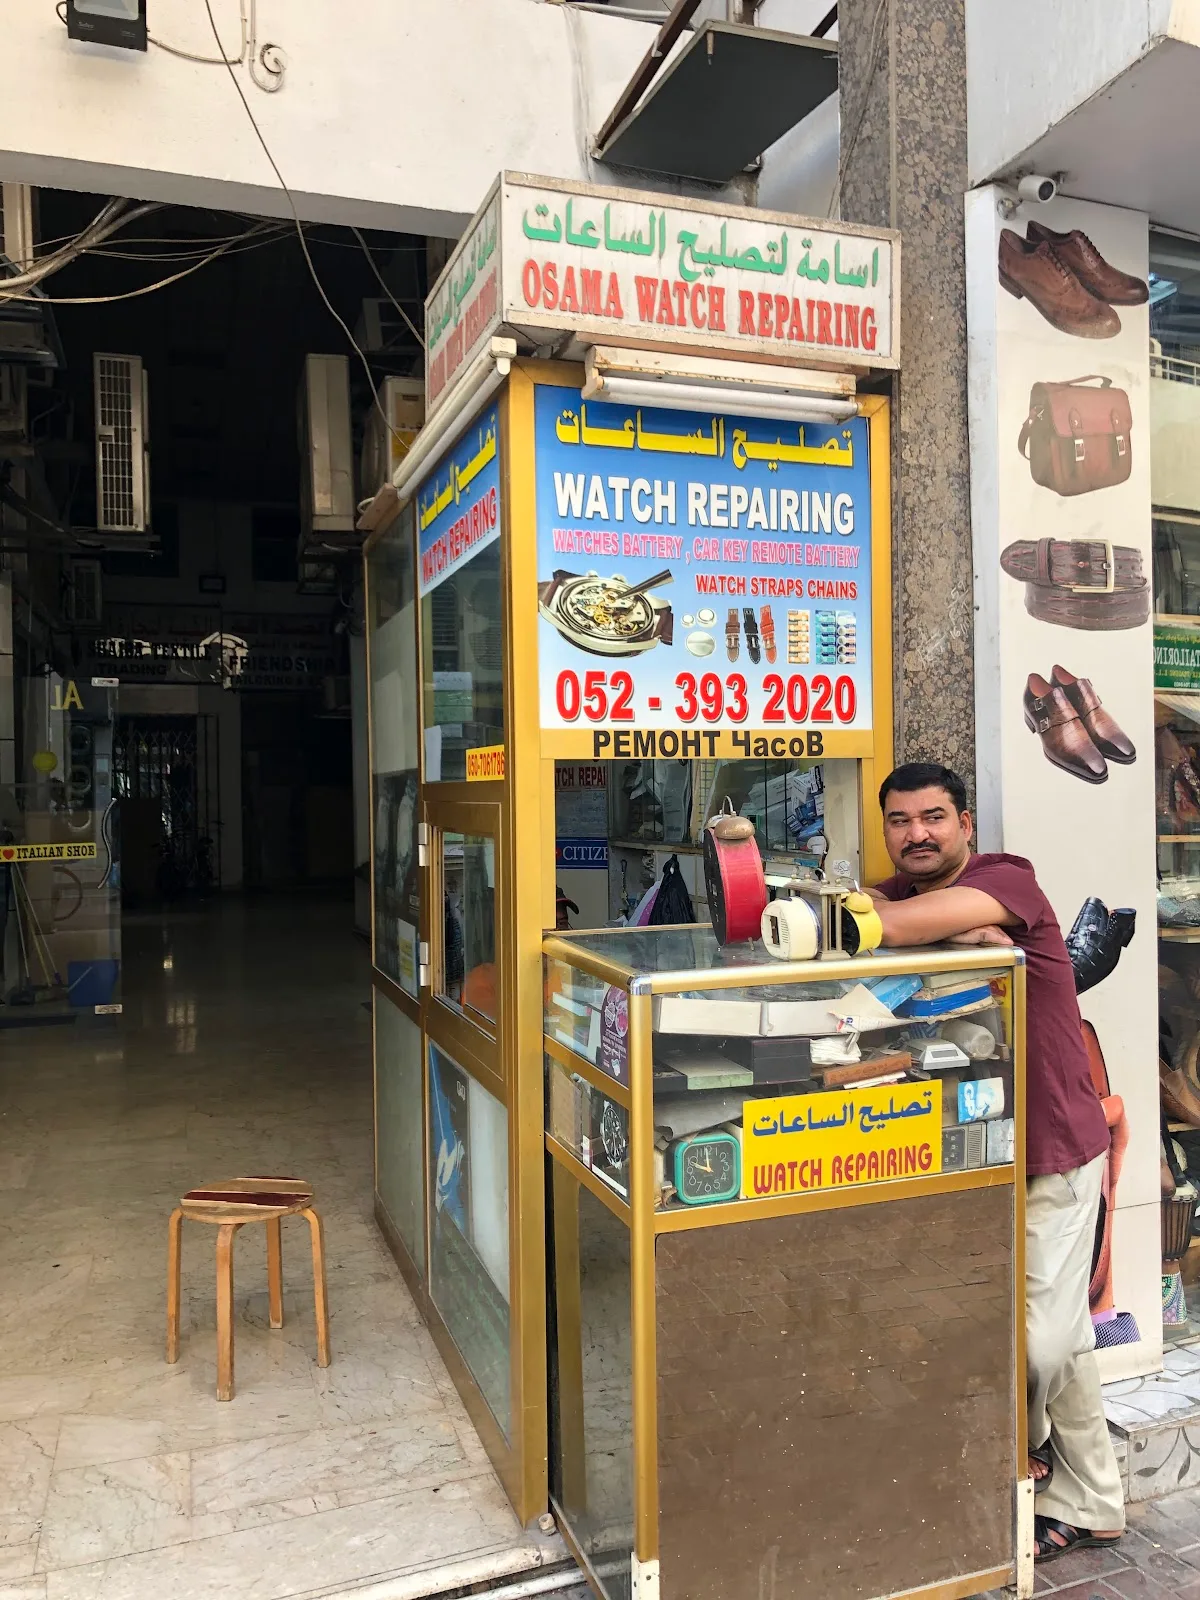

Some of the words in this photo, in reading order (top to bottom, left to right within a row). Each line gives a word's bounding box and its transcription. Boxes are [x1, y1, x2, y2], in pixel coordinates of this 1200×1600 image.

[522, 198, 666, 259] الساعات
[677, 222, 788, 282] لتصليح
[796, 238, 879, 288] اسامة
[522, 259, 623, 319] OSAMA
[635, 276, 726, 332] WATCH
[738, 289, 877, 351] REPAIRING
[555, 404, 725, 458] الساعات
[732, 425, 854, 472] تصليح
[553, 472, 677, 524] WATCH
[687, 482, 855, 535] REPAIRING
[422, 531, 448, 585] WATCH
[448, 486, 497, 560] REPAIRING
[552, 529, 620, 556] WATCHES
[622, 532, 683, 559] BATTERY
[692, 537, 720, 561] CAR
[722, 538, 749, 562] KEY
[751, 540, 803, 566] REMOTE
[804, 543, 861, 568] BATTERY
[695, 574, 747, 596] WATCH
[750, 576, 804, 598] STRAPS
[806, 579, 858, 600] CHAINS
[97, 662, 168, 676] TRADING
[229, 656, 336, 673] FRIENDSHIP
[556, 669, 635, 722] 052
[674, 672, 749, 723] 393
[762, 673, 857, 724] 2020
[555, 767, 575, 787] TCH
[17, 847, 64, 859] ITALIAN
[66, 845, 94, 857] SHOE
[752, 1101, 854, 1137] الساعات
[859, 1090, 932, 1133] تصليح
[719, 1152, 727, 1162] 2
[722, 1161, 730, 1172] 3
[753, 1158, 822, 1195] WATCH
[831, 1142, 933, 1184] REPAIRING
[695, 1181, 703, 1193] 7
[704, 1182, 712, 1193] 6
